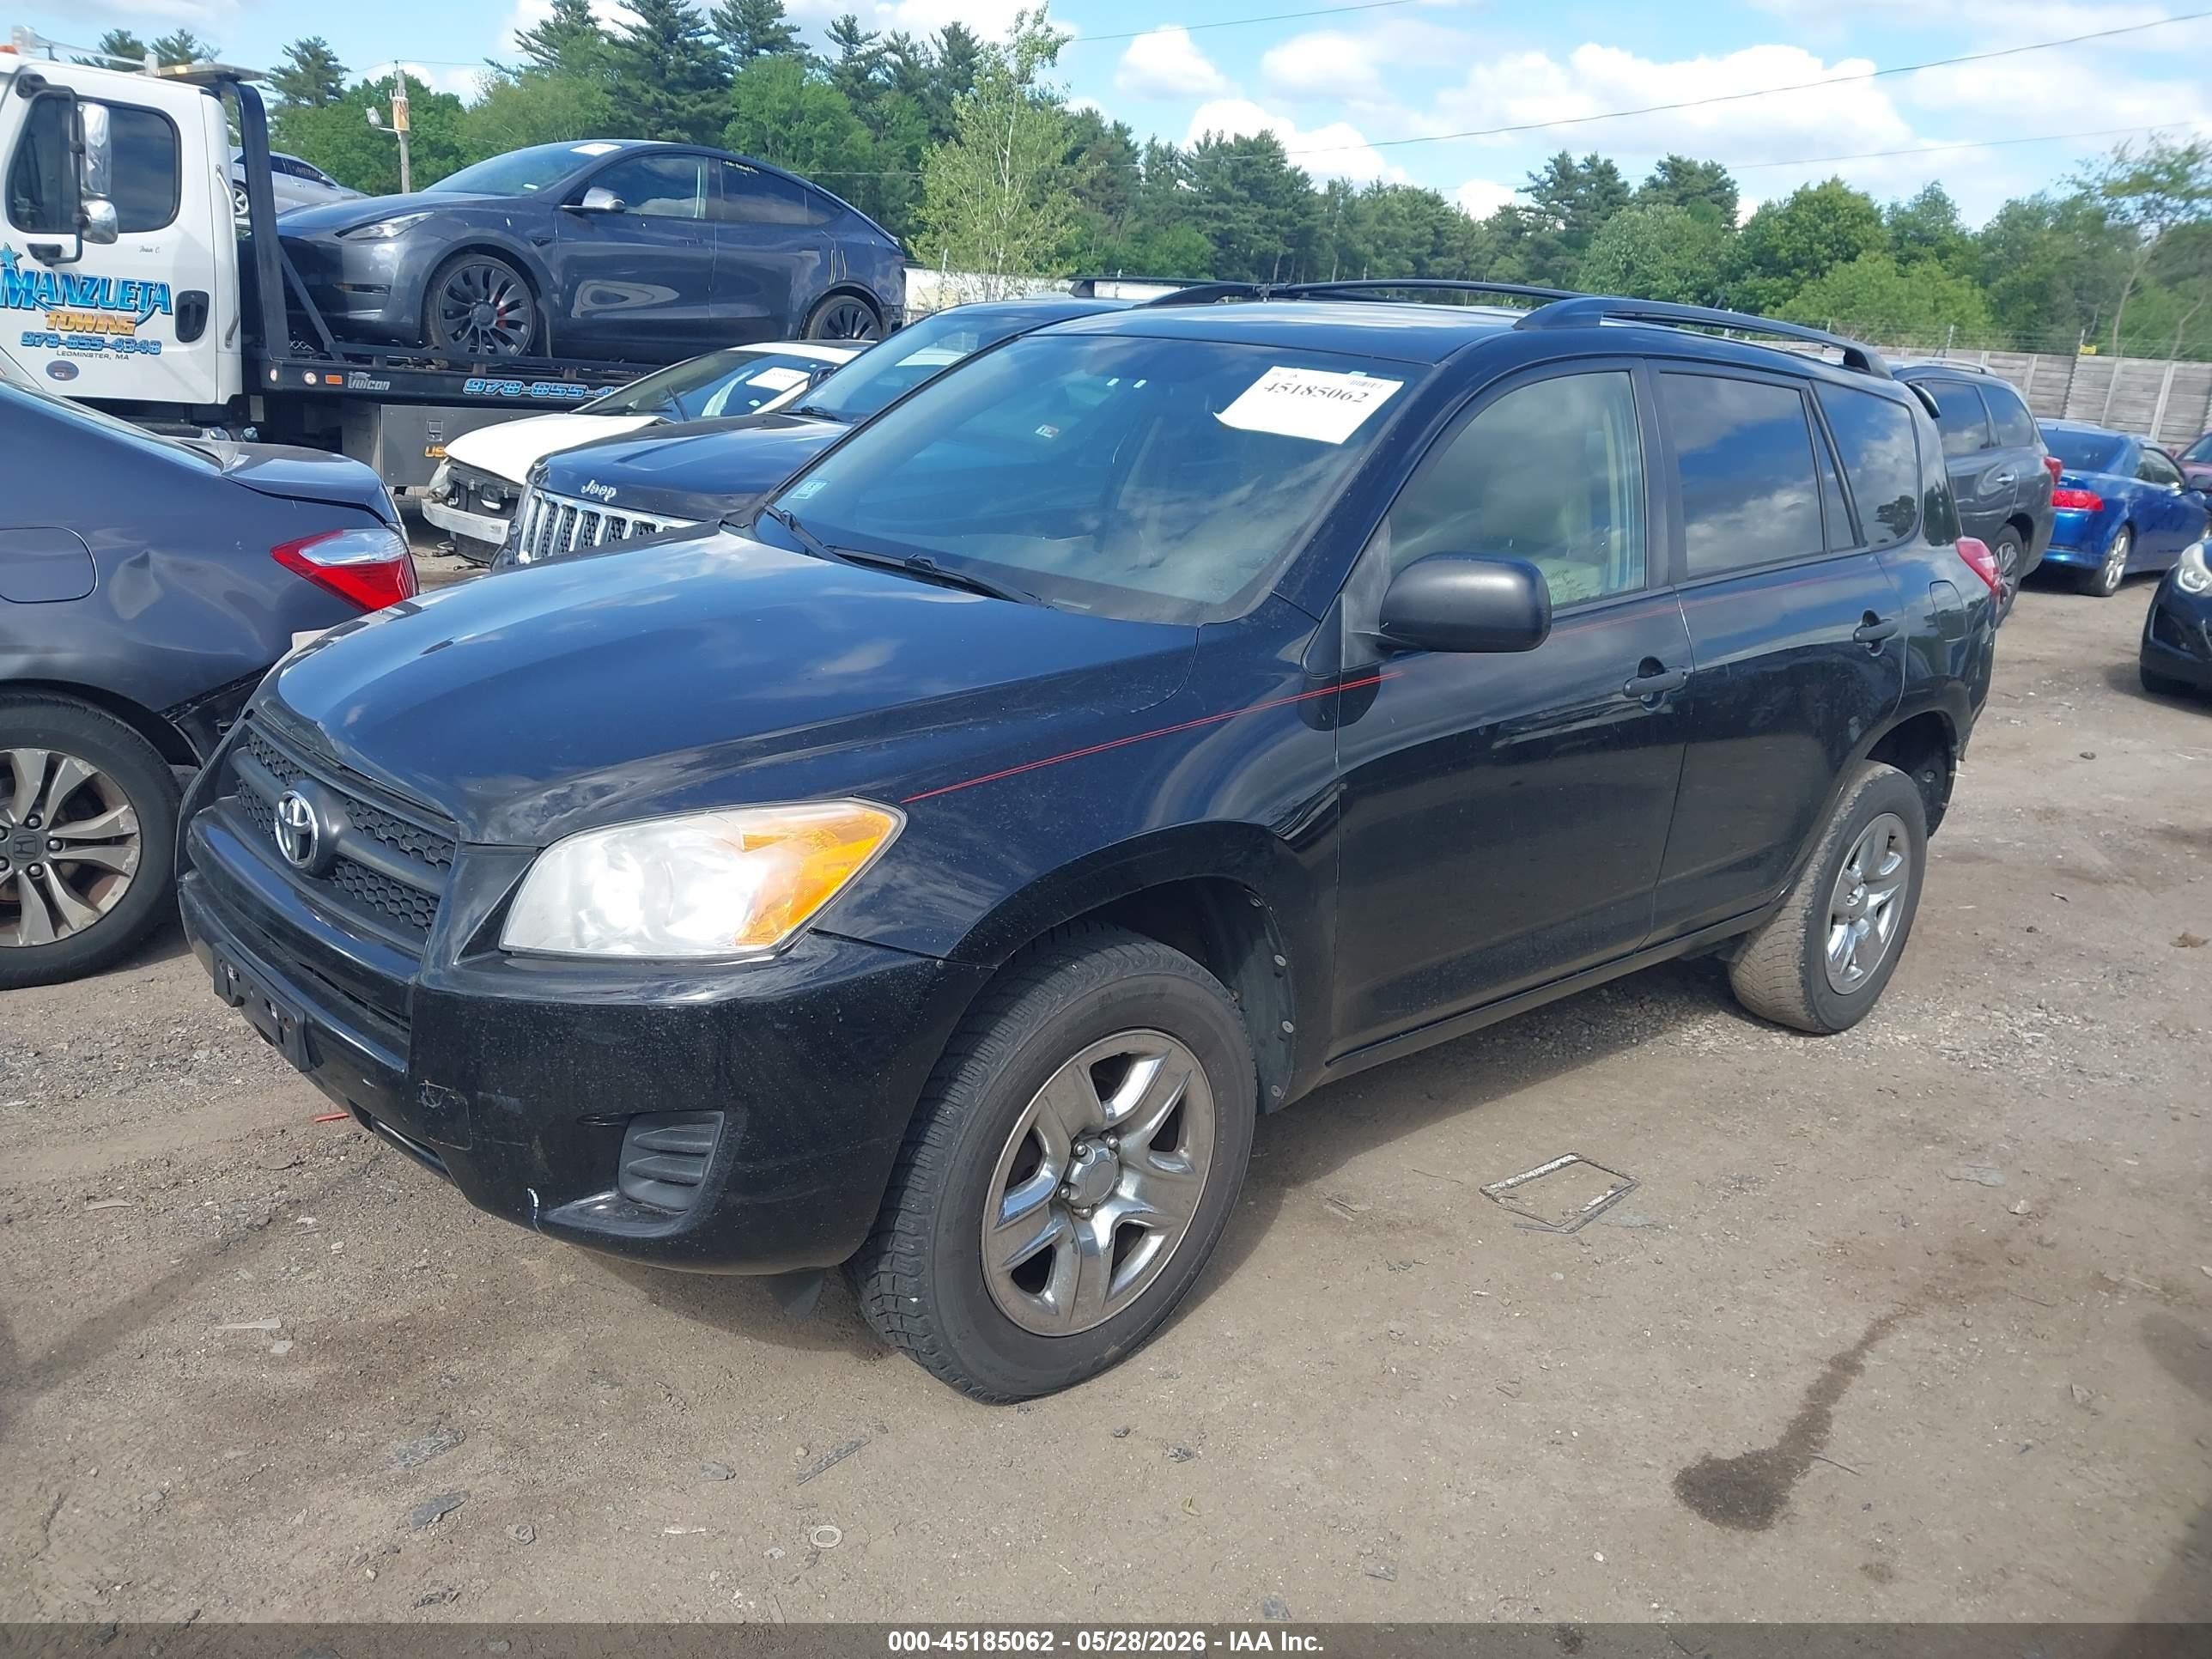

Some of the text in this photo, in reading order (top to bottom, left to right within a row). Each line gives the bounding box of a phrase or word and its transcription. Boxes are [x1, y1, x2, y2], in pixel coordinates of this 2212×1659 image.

[0, 267, 173, 315] MANZUETA
[45, 310, 137, 336] TOWING
[21, 331, 161, 355] 978-855-4348
[56, 349, 112, 360] LEOMINSTER,
[1263, 381, 1370, 404] 45185062
[580, 479, 617, 501] Jeep
